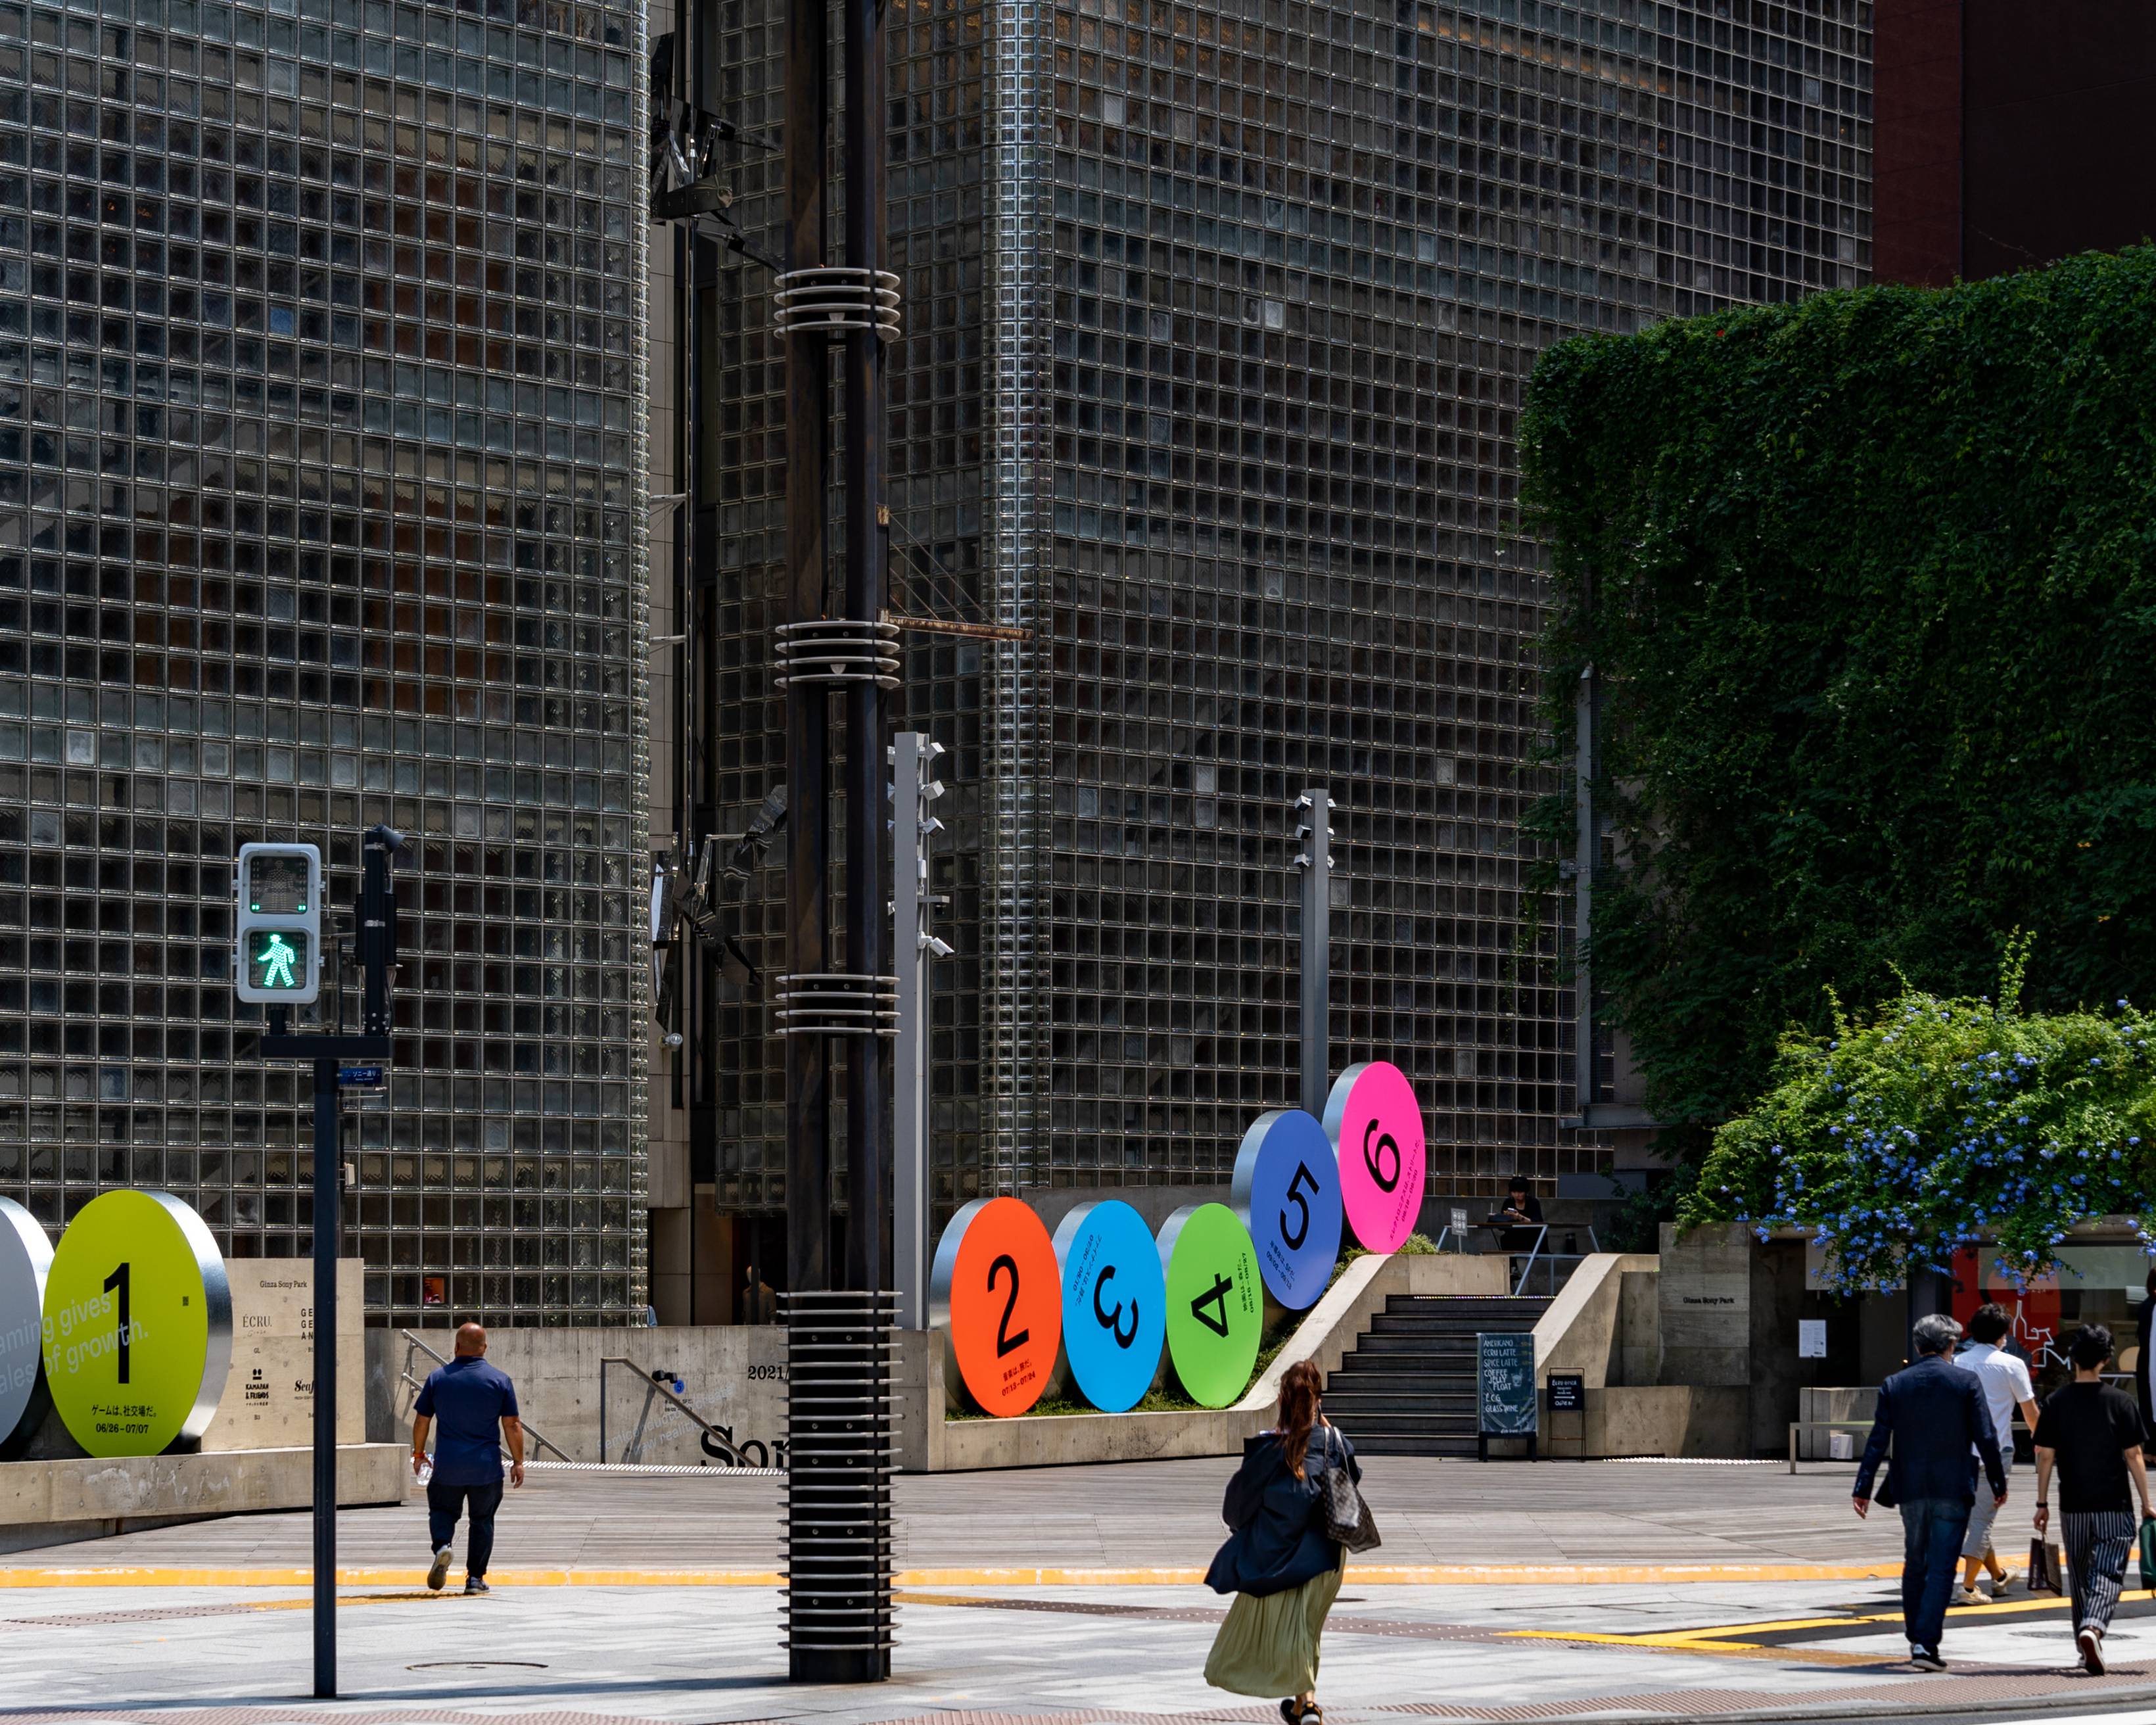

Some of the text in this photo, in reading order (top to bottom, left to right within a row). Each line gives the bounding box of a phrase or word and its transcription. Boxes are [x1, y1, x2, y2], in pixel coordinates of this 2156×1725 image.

[1363, 1118, 1401, 1193] 6
[1280, 1160, 1320, 1250] 5
[60, 1293, 111, 1336] gives
[278, 1281, 293, 1289] Sony
[987, 1254, 1029, 1359] 2
[1094, 1265, 1138, 1349] 3
[1190, 1273, 1233, 1338] 4
[43, 1344, 60, 1377] of
[67, 1315, 148, 1373] growth.
[104, 1262, 129, 1384] 1
[1484, 1369, 1508, 1378] COFFEE
[1488, 1375, 1507, 1384] JELLY
[92, 1404, 156, 1417] ゲームは、社交場だ。
